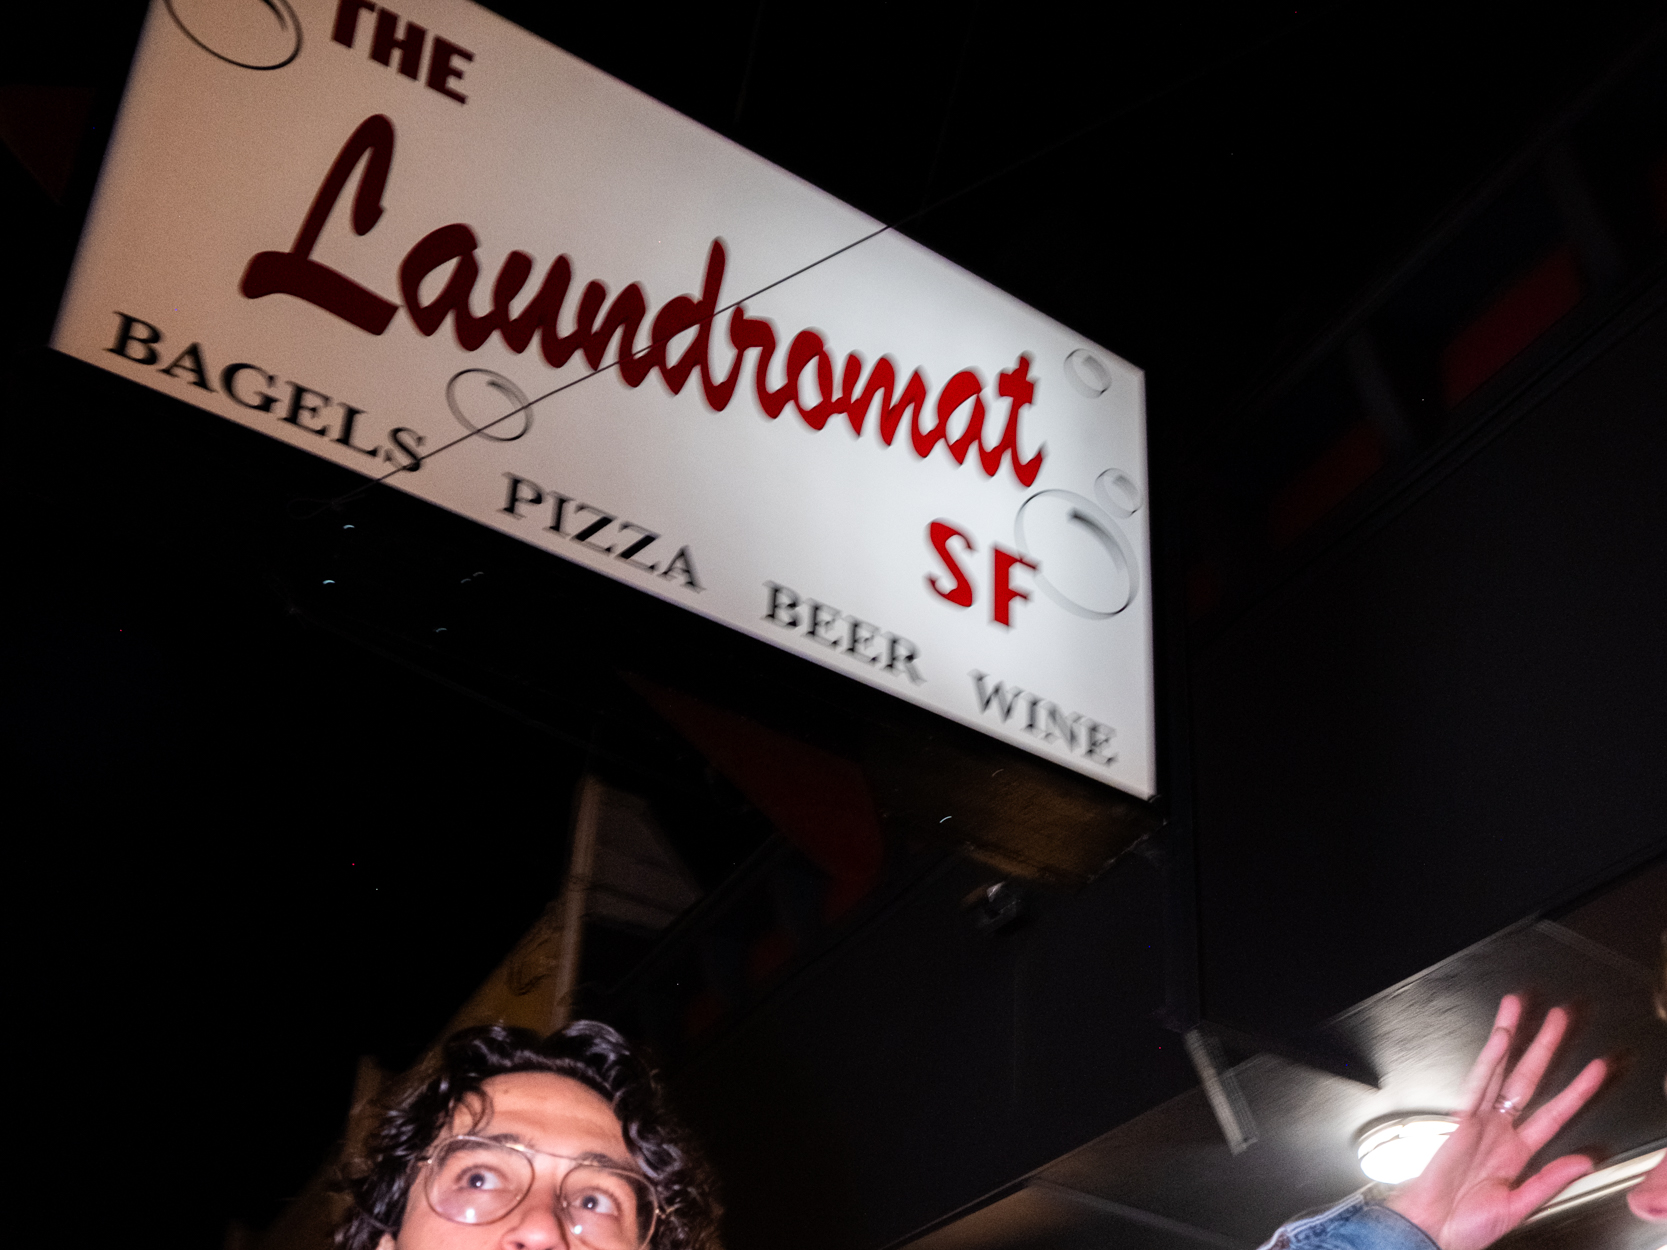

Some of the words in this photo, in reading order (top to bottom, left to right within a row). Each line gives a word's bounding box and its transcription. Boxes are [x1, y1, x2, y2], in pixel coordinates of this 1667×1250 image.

[331, 0, 475, 106] THE
[239, 113, 1048, 488] Laundromat
[103, 310, 427, 472] BAGELS
[496, 471, 707, 594] PIZZA
[760, 580, 928, 686] BEER
[968, 668, 1120, 768] WINE
[923, 517, 1042, 629] SF
